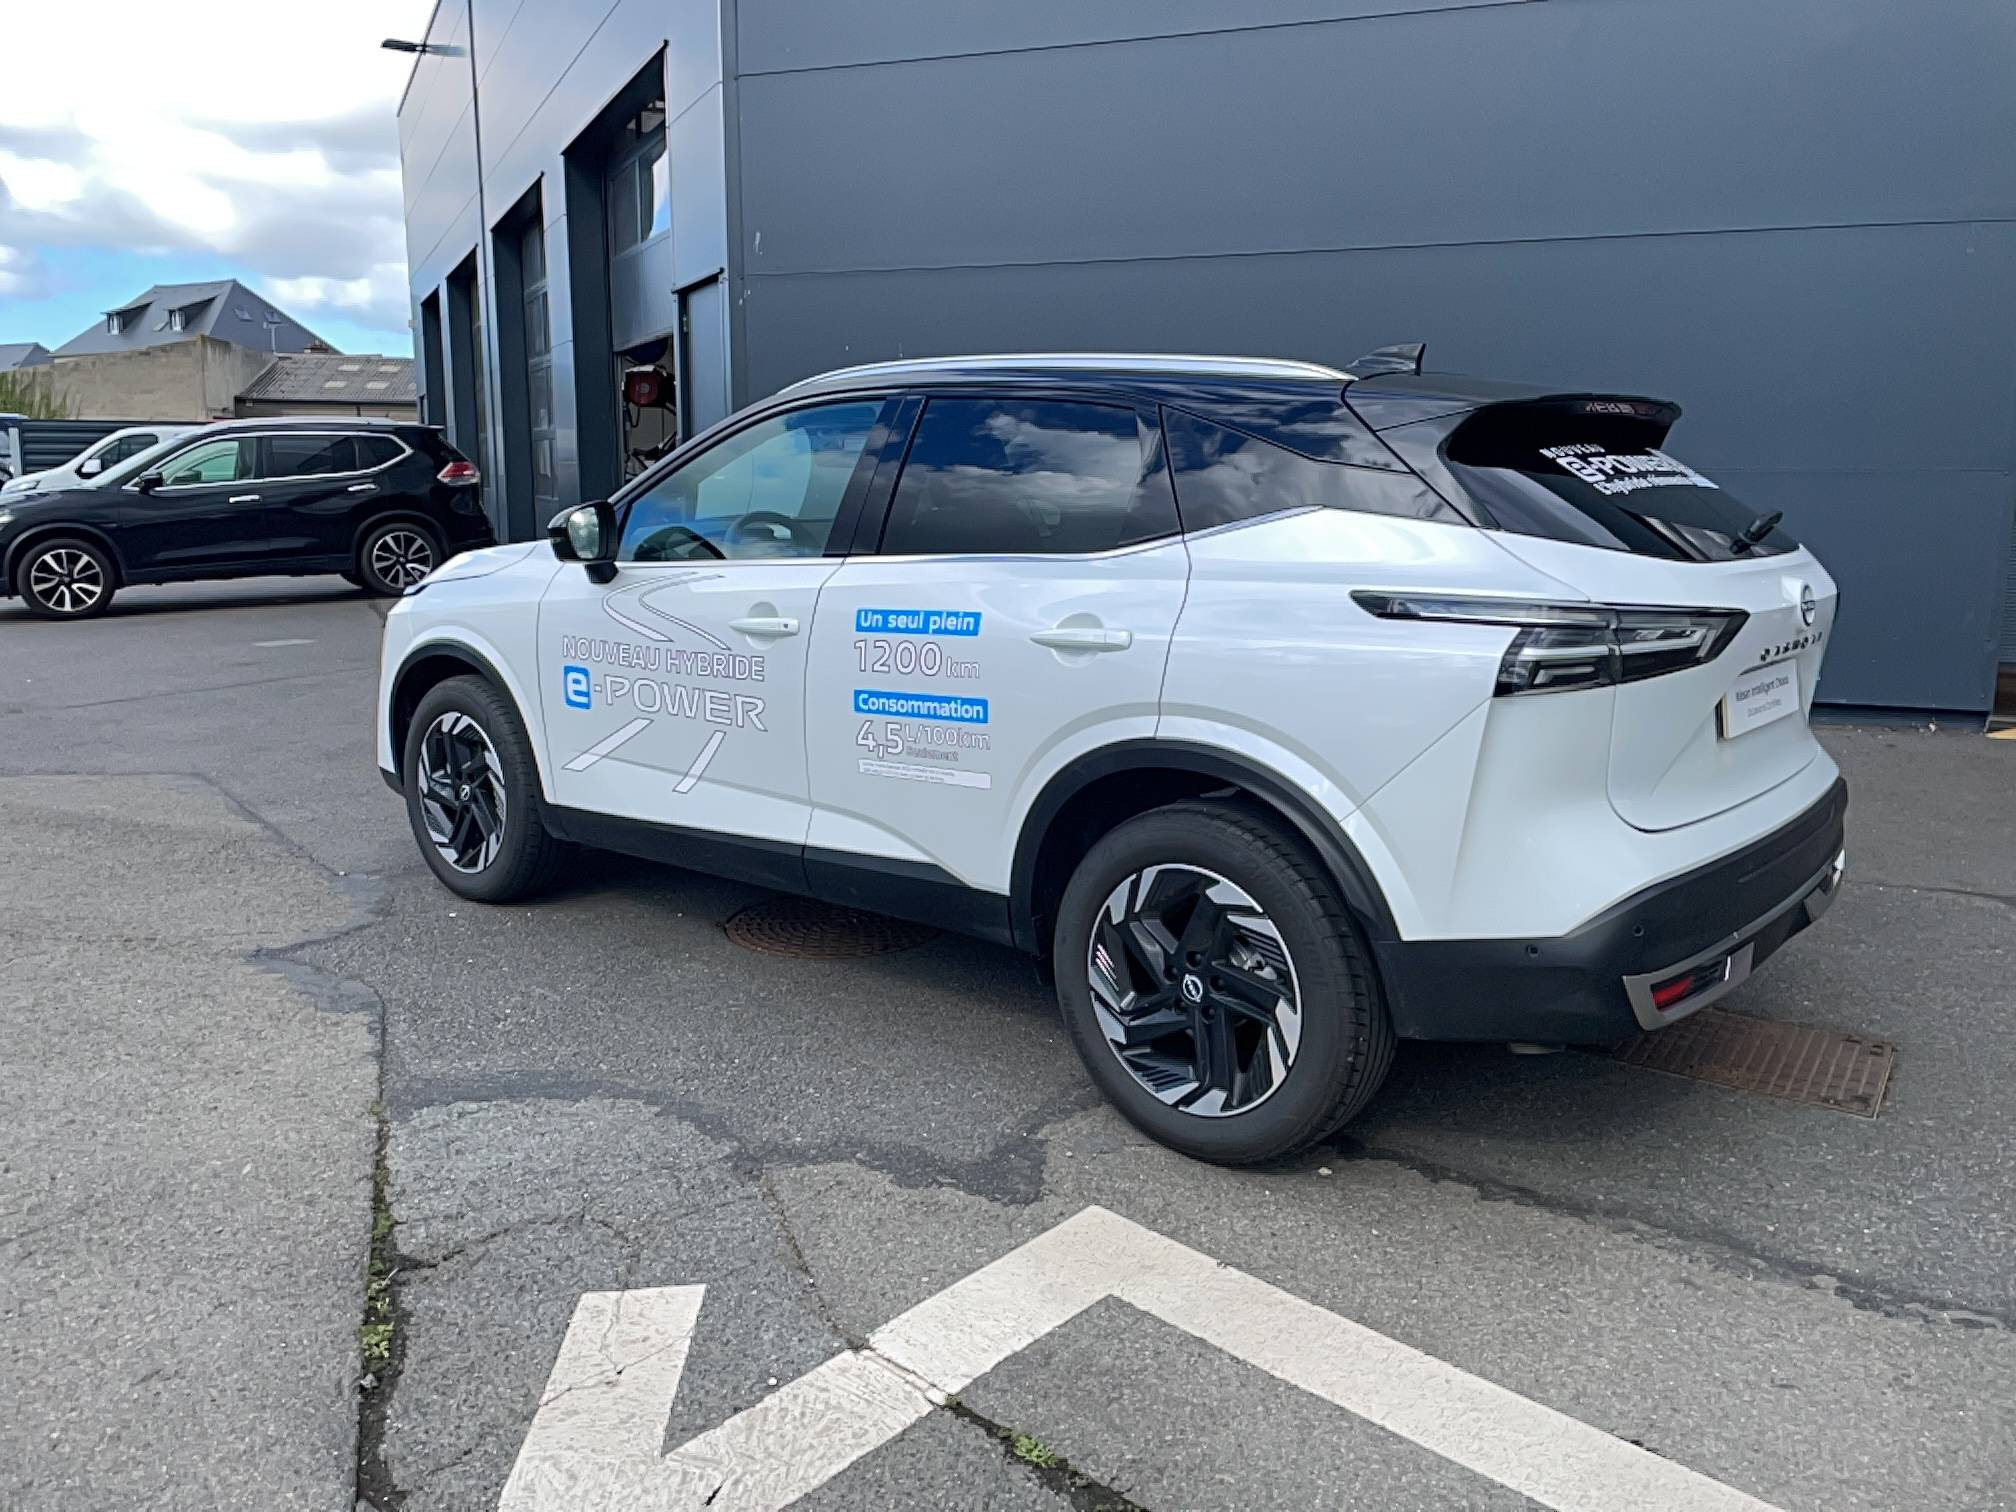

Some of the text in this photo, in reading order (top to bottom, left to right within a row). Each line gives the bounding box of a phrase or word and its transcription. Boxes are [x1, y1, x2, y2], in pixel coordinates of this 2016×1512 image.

[860, 611, 974, 633] Un seul plein
[562, 635, 766, 681] NOUVEAU HYBRIDE
[854, 639, 980, 679] 1200 km
[562, 664, 769, 732] e-POWER
[857, 693, 984, 720] Consommation
[856, 719, 904, 760] 4,5
